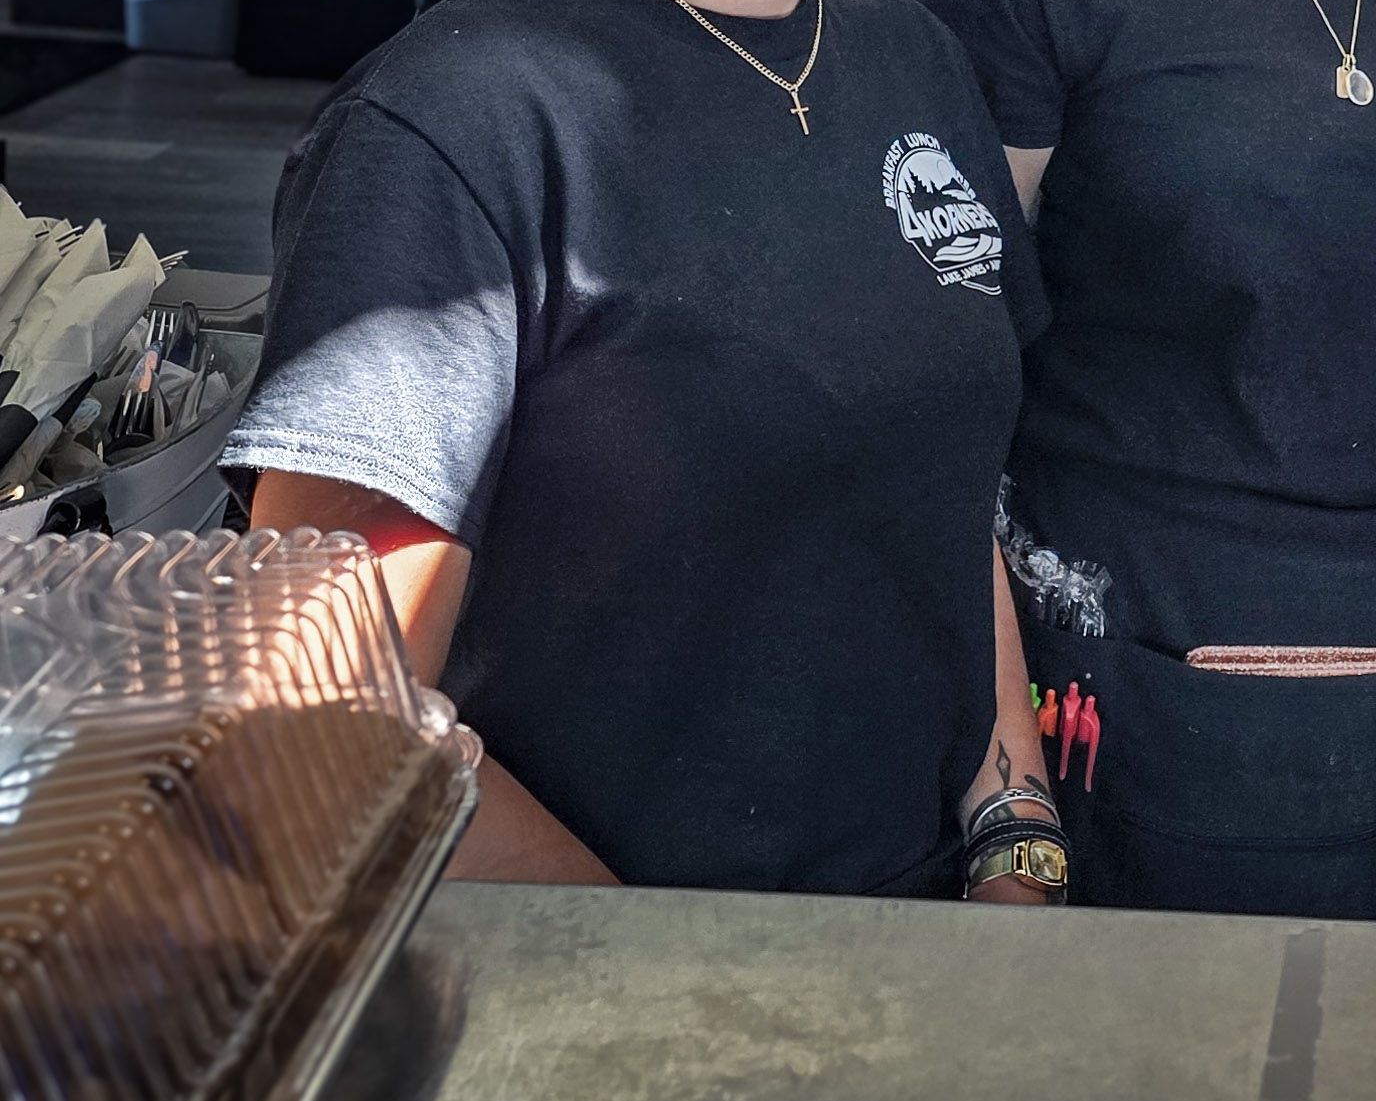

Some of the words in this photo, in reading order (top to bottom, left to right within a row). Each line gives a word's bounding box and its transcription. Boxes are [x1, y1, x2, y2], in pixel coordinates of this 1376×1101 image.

[882, 139, 905, 210] BREAKFAST
[904, 132, 941, 150] LUNCH
[936, 272, 961, 286] LAKE
[961, 263, 988, 280] JAMES
